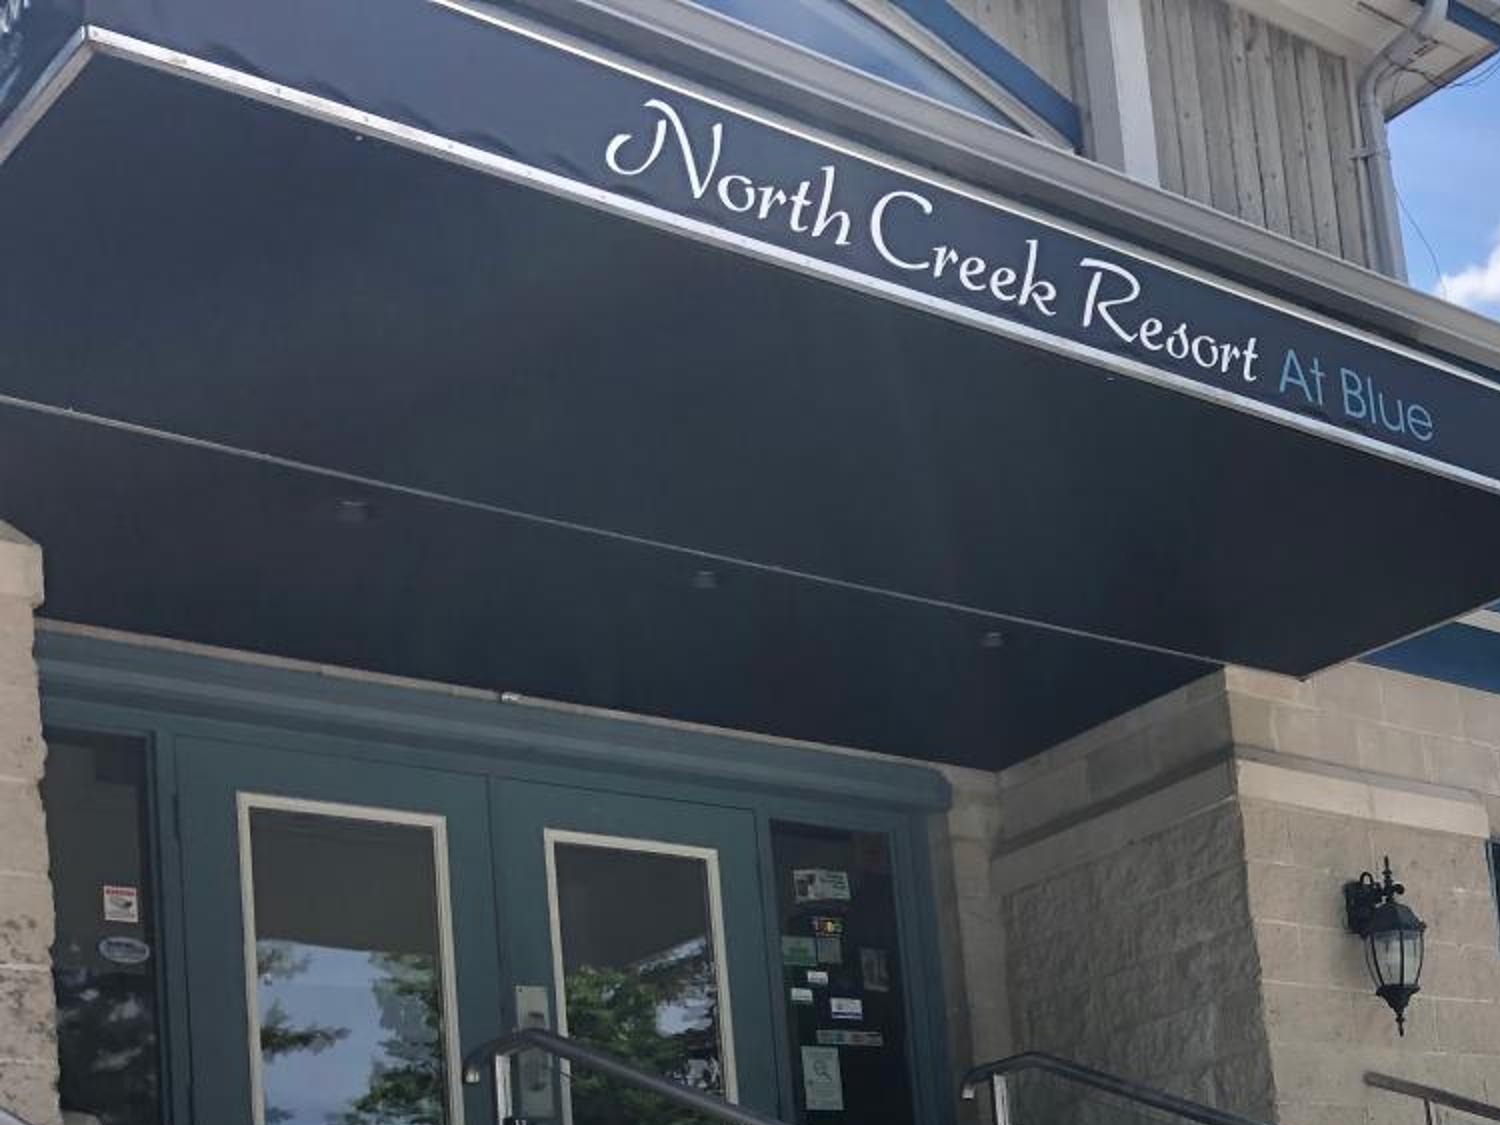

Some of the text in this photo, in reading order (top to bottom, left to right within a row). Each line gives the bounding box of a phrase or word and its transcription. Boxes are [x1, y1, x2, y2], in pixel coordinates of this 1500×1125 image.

[604, 98, 1435, 442] North Creek Resort At Blue
